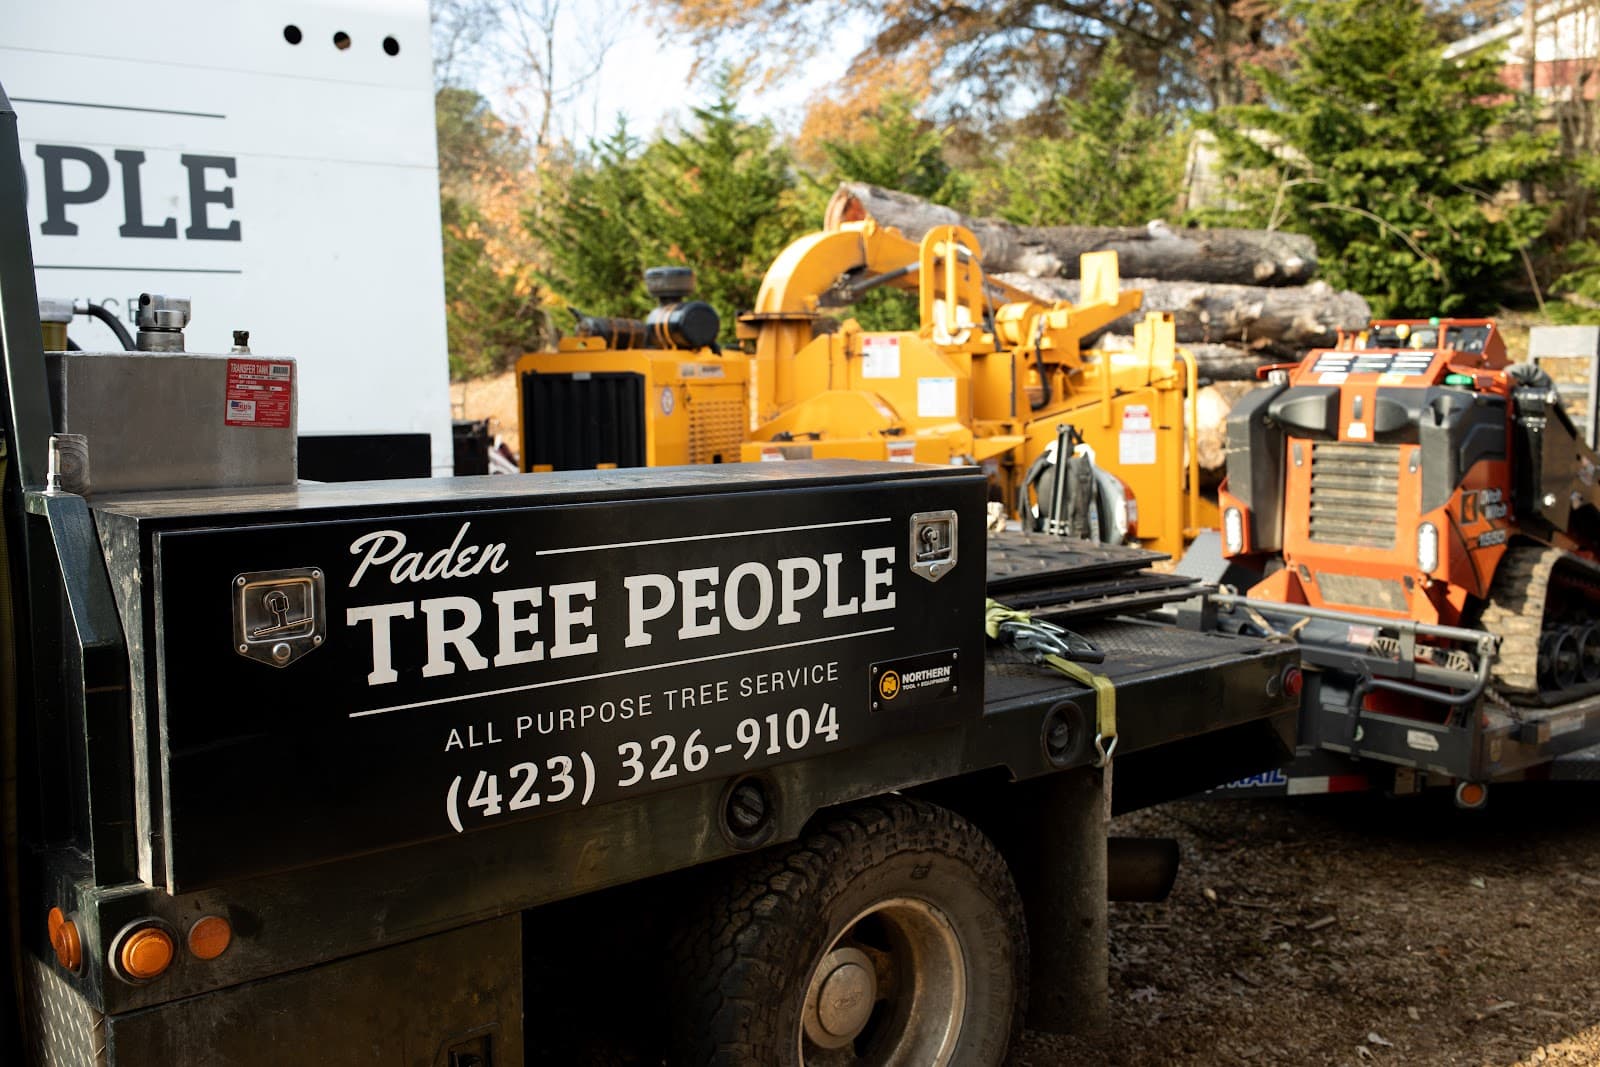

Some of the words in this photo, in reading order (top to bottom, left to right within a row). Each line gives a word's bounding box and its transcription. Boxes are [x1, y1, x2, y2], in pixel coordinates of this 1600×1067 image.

[21, 143, 242, 241] PLE
[348, 521, 509, 588] Paden
[346, 580, 598, 686] TREE
[623, 546, 896, 648] PEOPLE
[445, 721, 502, 752] ALL
[516, 693, 653, 739] PURPOSE
[663, 680, 730, 711] TREE
[739, 661, 840, 698] SERVICE
[902, 666, 951, 684] NORTHERN
[446, 750, 597, 833] (423)
[617, 702, 840, 787] 326-9104
